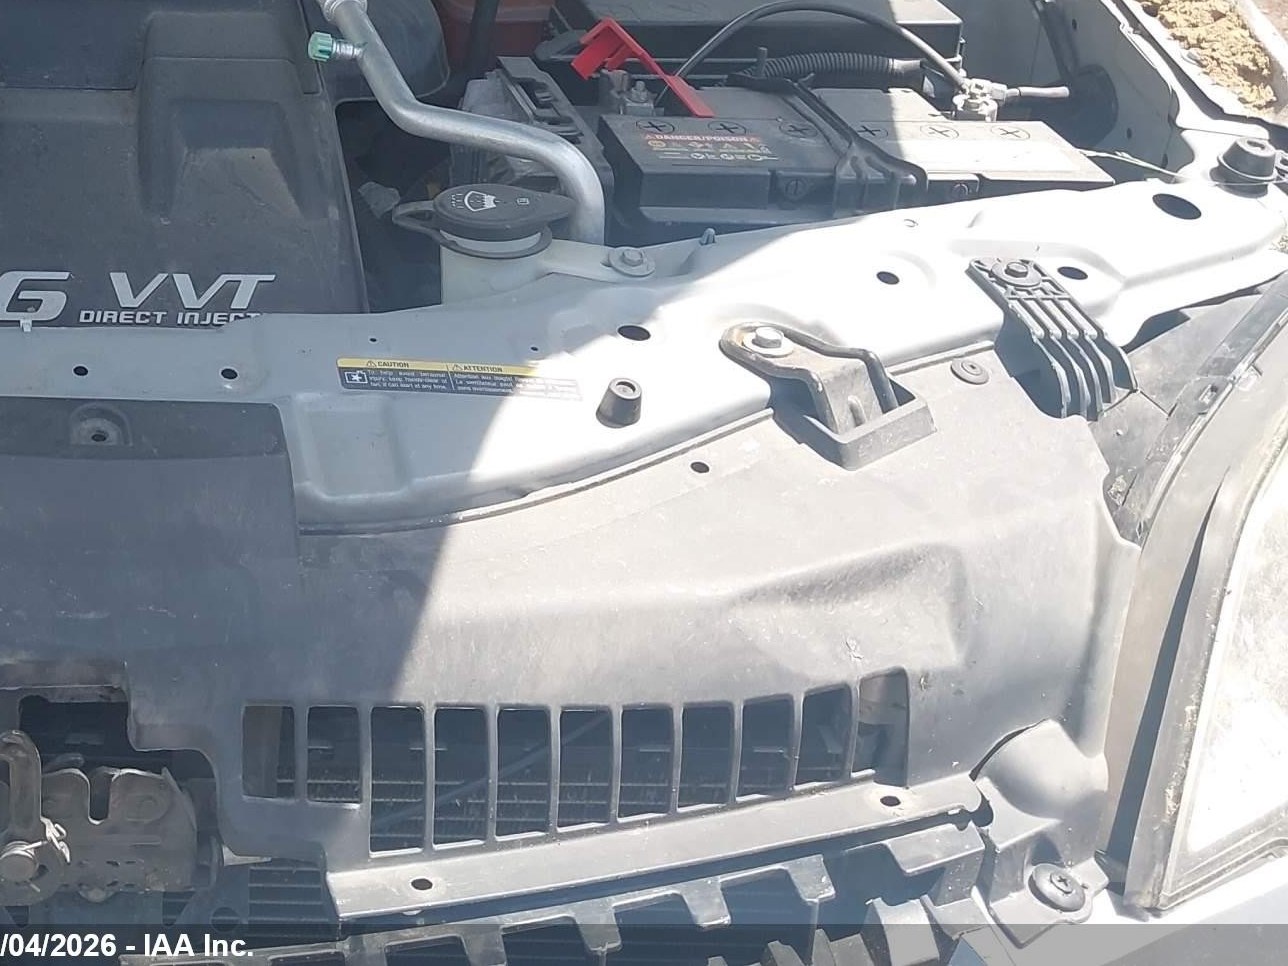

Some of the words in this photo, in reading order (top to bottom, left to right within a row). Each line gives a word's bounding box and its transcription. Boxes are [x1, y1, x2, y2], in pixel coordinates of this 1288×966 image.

[110, 272, 276, 309] VVT
[79, 310, 168, 324] DIRECT
[463, 365, 503, 373] ATTENTION
